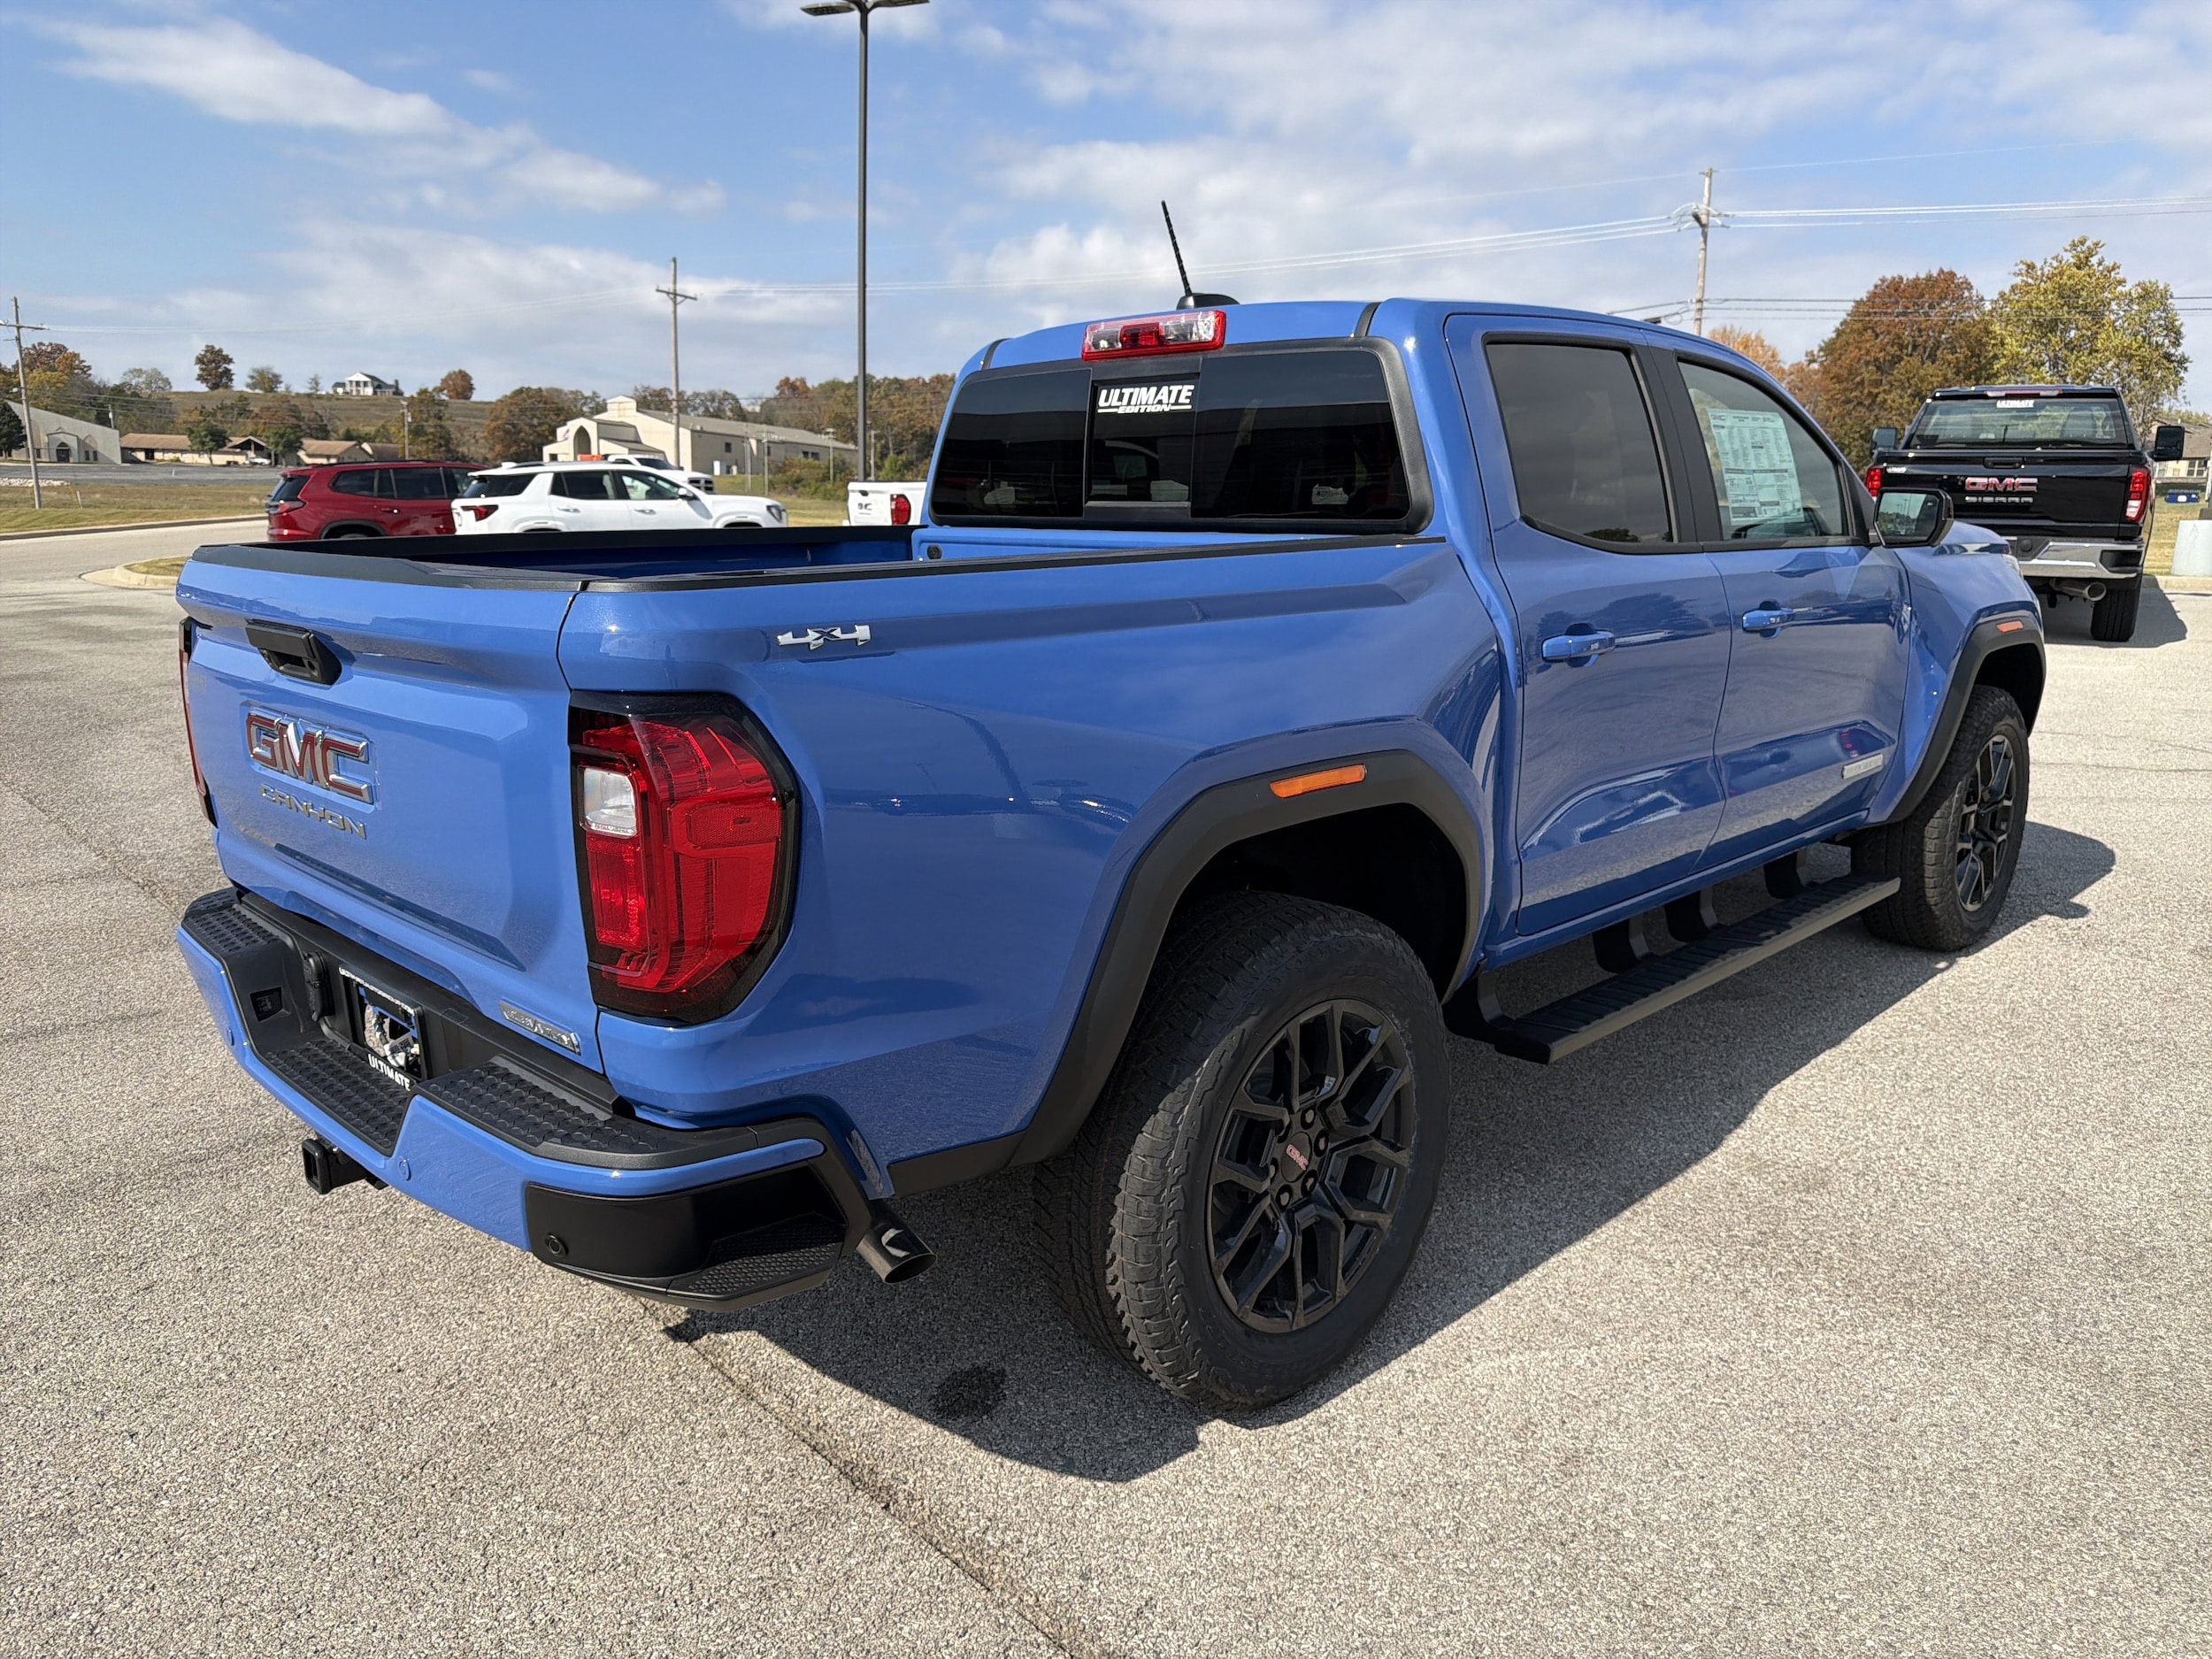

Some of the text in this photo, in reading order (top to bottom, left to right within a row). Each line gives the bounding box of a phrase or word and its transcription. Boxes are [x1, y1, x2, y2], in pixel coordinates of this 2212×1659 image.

[1098, 385, 1195, 407] ULTIMATE
[1117, 403, 1172, 414] EDITION
[1965, 477, 2039, 492] GMC
[246, 708, 375, 805] GMC
[259, 783, 367, 840] CANYON
[367, 1053, 411, 1092] ULTIMATE
[1286, 1144, 1309, 1171] GMC
